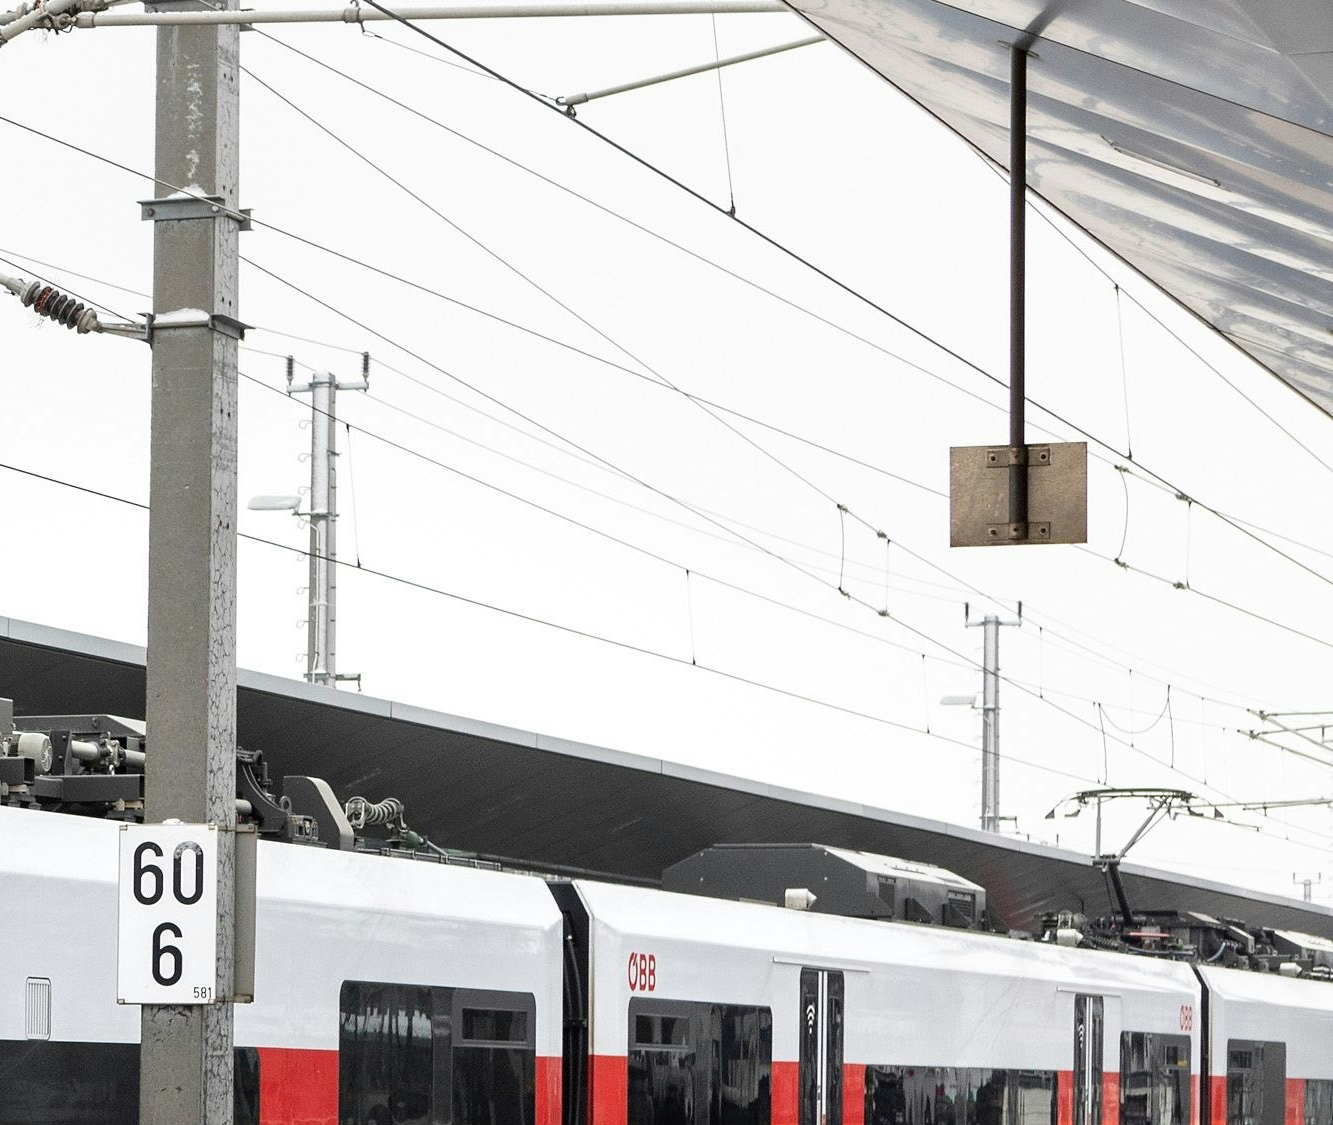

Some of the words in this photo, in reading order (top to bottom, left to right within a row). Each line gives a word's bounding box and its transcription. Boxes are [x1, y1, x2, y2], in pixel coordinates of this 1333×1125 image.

[133, 841, 204, 905] 60
[152, 922, 183, 986] 6
[628, 952, 656, 991] ÖBB
[193, 987, 213, 999] 581
